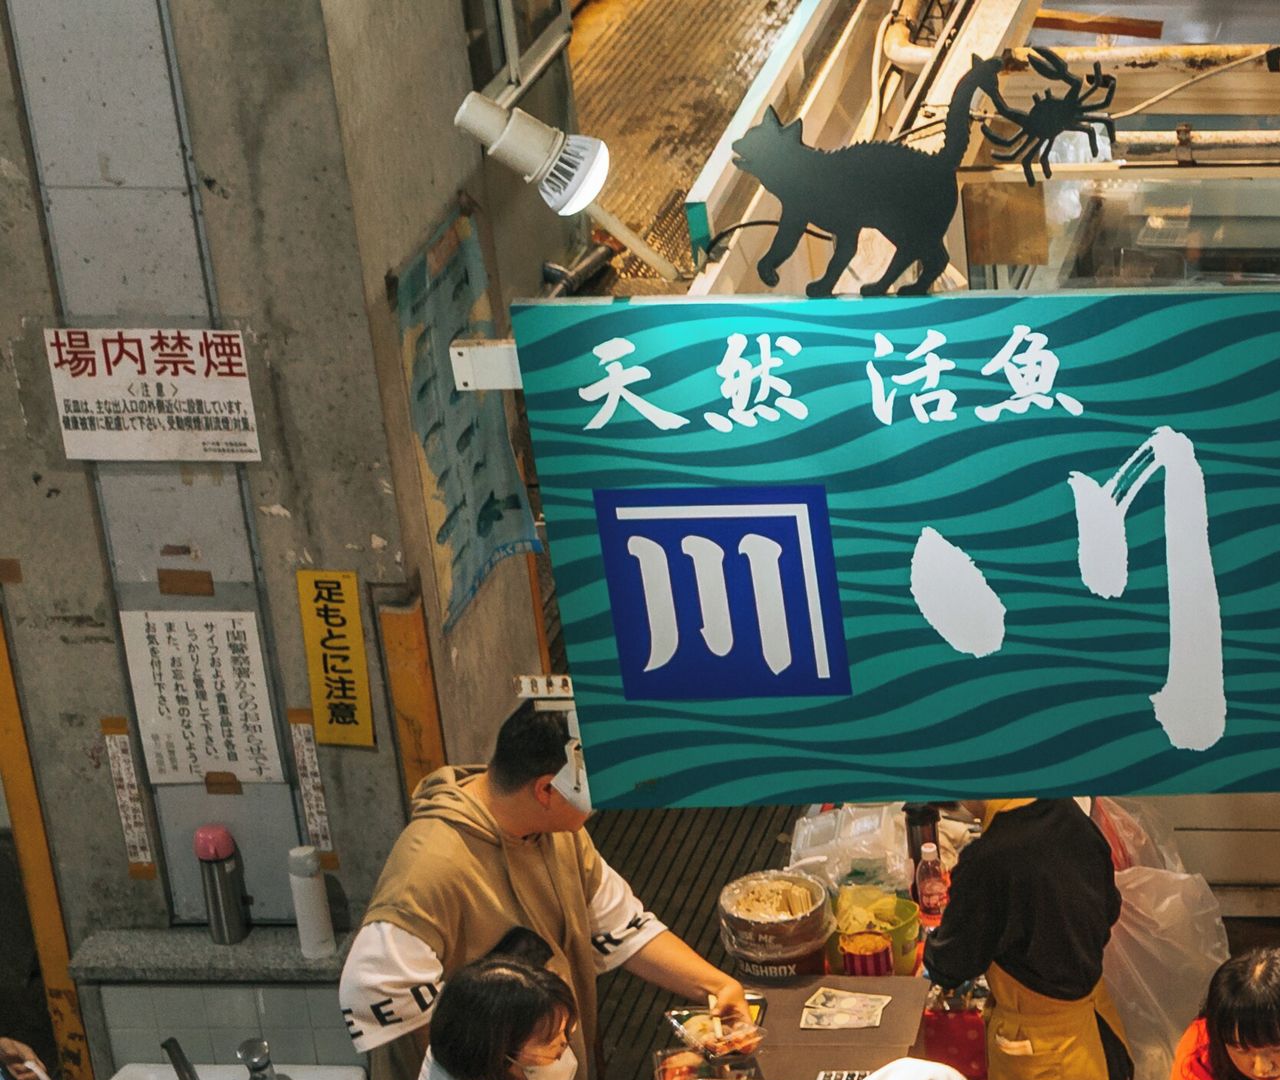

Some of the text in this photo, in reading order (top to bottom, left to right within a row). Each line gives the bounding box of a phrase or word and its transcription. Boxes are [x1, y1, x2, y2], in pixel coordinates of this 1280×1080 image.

[50, 330, 247, 378] 場内禁煙
[578, 324, 1084, 432] 天然 活魚
[313, 579, 360, 726] 足もとに注意
